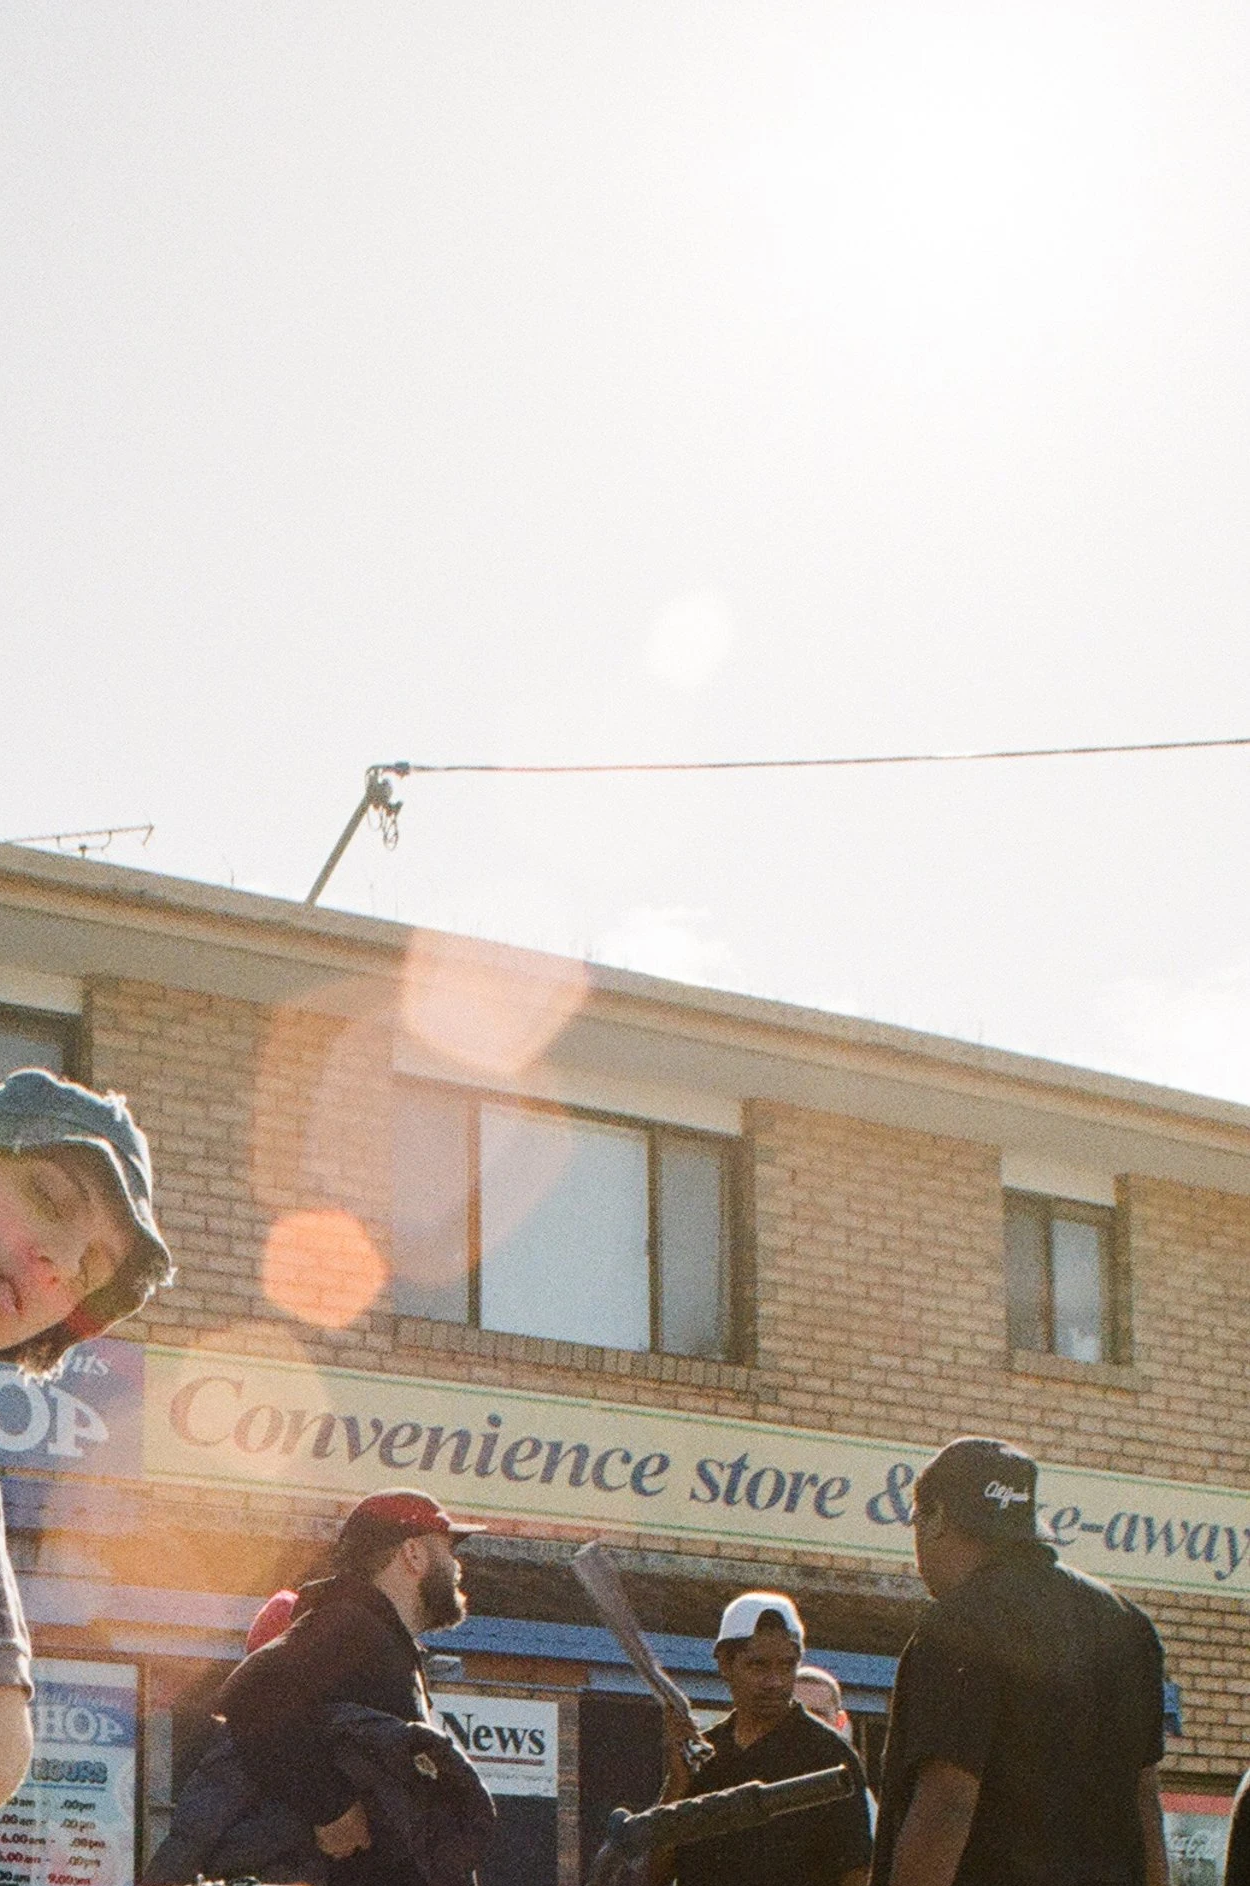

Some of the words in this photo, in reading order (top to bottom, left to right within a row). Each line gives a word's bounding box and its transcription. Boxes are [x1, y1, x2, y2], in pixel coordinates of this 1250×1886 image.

[168, 1376, 671, 1498] Convenience
[690, 1452, 851, 1519] store
[865, 1462, 914, 1526] &
[1036, 1500, 1250, 1580] e-away
[440, 1711, 546, 1755] News
